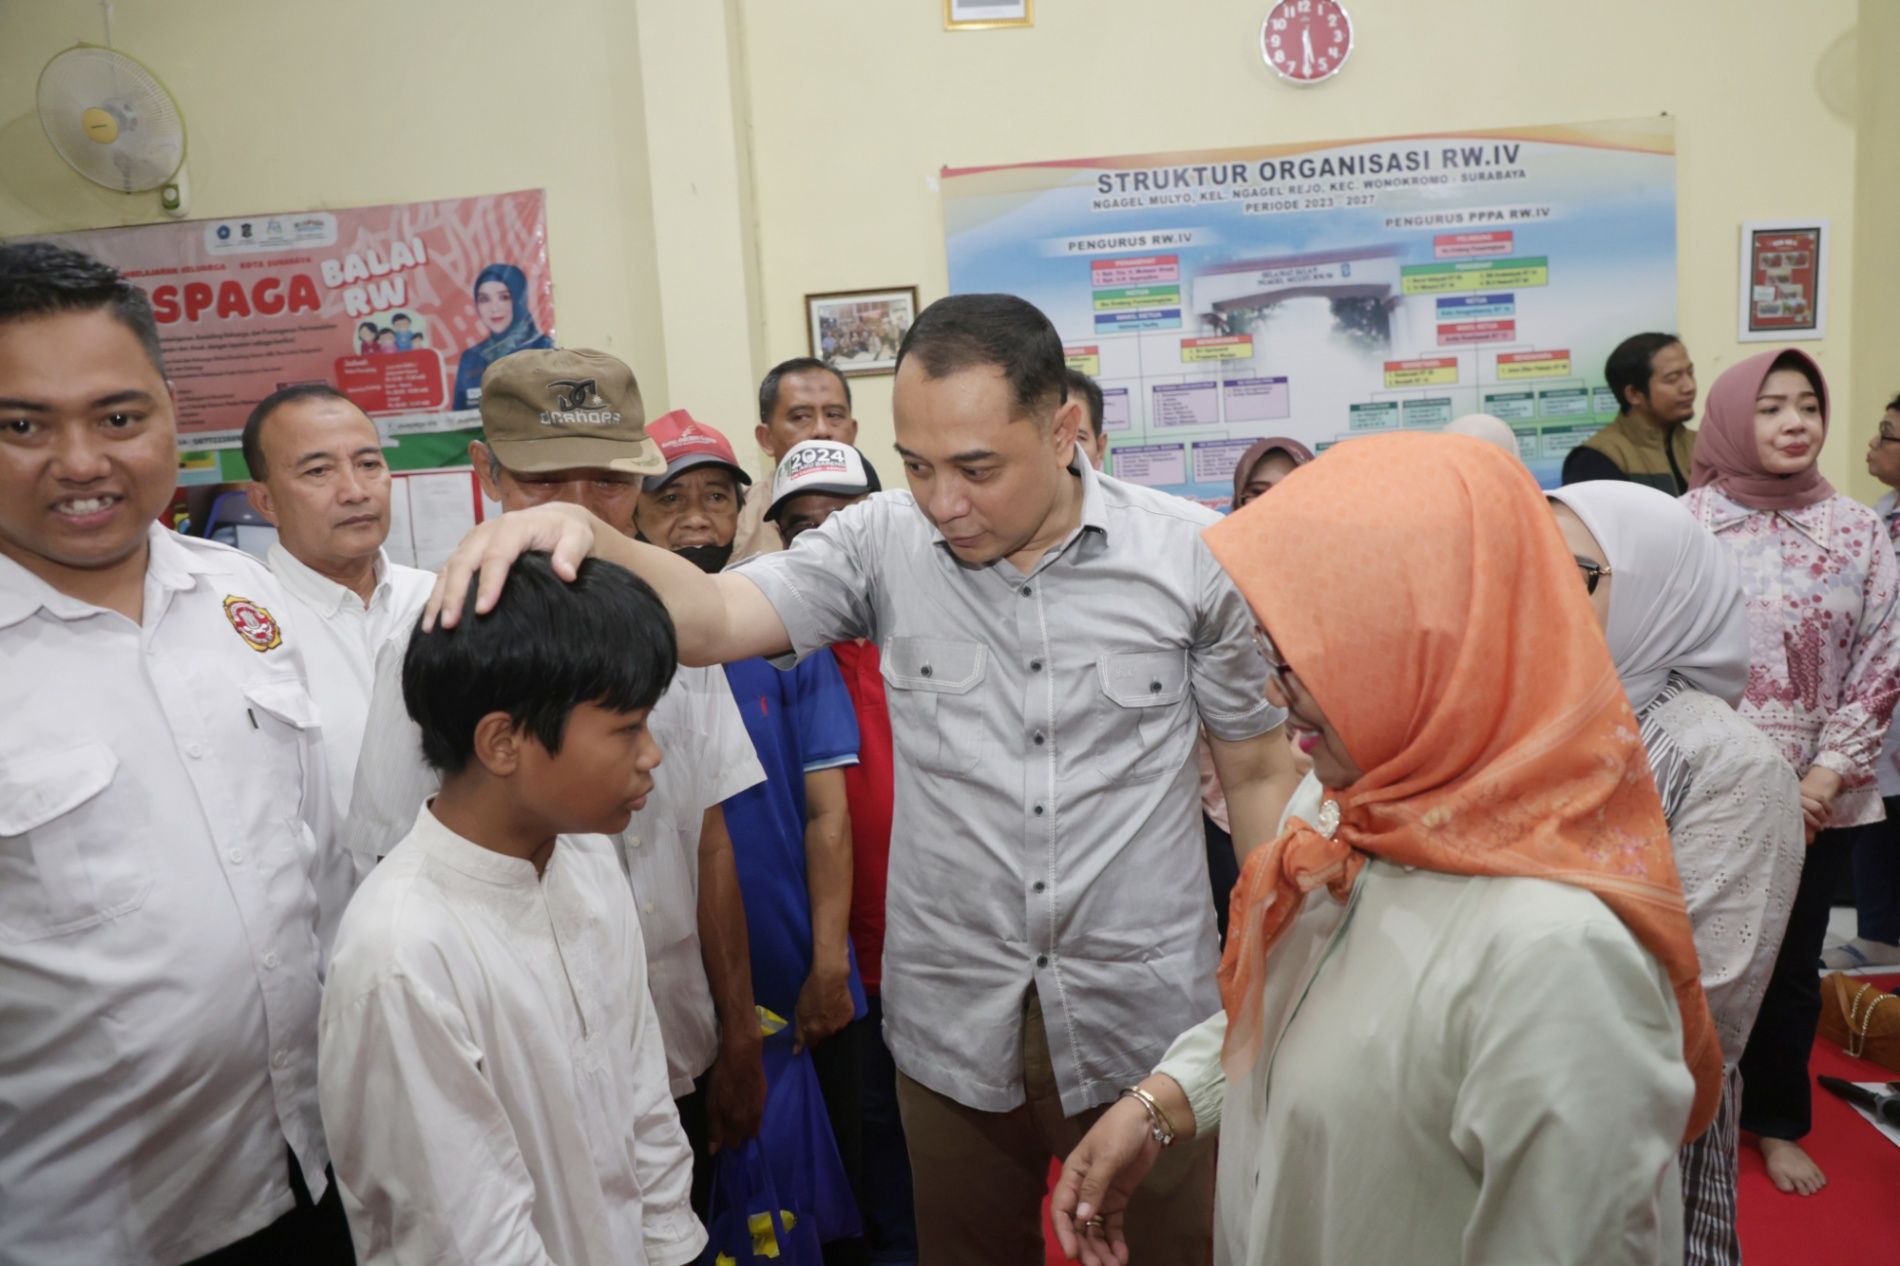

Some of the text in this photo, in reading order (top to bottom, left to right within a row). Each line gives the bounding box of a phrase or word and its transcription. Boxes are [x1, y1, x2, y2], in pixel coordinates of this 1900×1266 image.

[1284, 5, 1296, 18] 11
[1298, 0, 1311, 12] 12
[1318, 4, 1324, 16] 1
[1272, 18, 1287, 30] 10
[1328, 14, 1338, 27] 2
[1271, 34, 1281, 47] 9
[1333, 29, 1343, 43] 3
[1274, 50, 1285, 63] 8
[1328, 47, 1339, 59] 4
[1286, 60, 1297, 73] 7
[1318, 57, 1329, 72] 5
[1097, 143, 1520, 194] STRUKTUR ORGANISASI RW.IV
[1093, 197, 1143, 209] NGAGEL
[1233, 186, 1282, 199] NGAGEL
[1364, 174, 1448, 189] WONOKROMO
[1461, 169, 1526, 182] SURABAYA
[1245, 200, 1299, 212] PERIODE
[1305, 198, 1334, 209] 2023
[1347, 194, 1375, 206] 2027
[1385, 207, 1550, 228] PENGURUS PPPA RW.IV
[1068, 233, 1193, 251] PENGURUS RW.IV
[321, 236, 427, 287] BALAI
[138, 274, 321, 324] SPAGA
[343, 276, 406, 317] RW
[791, 448, 844, 469] 2024
